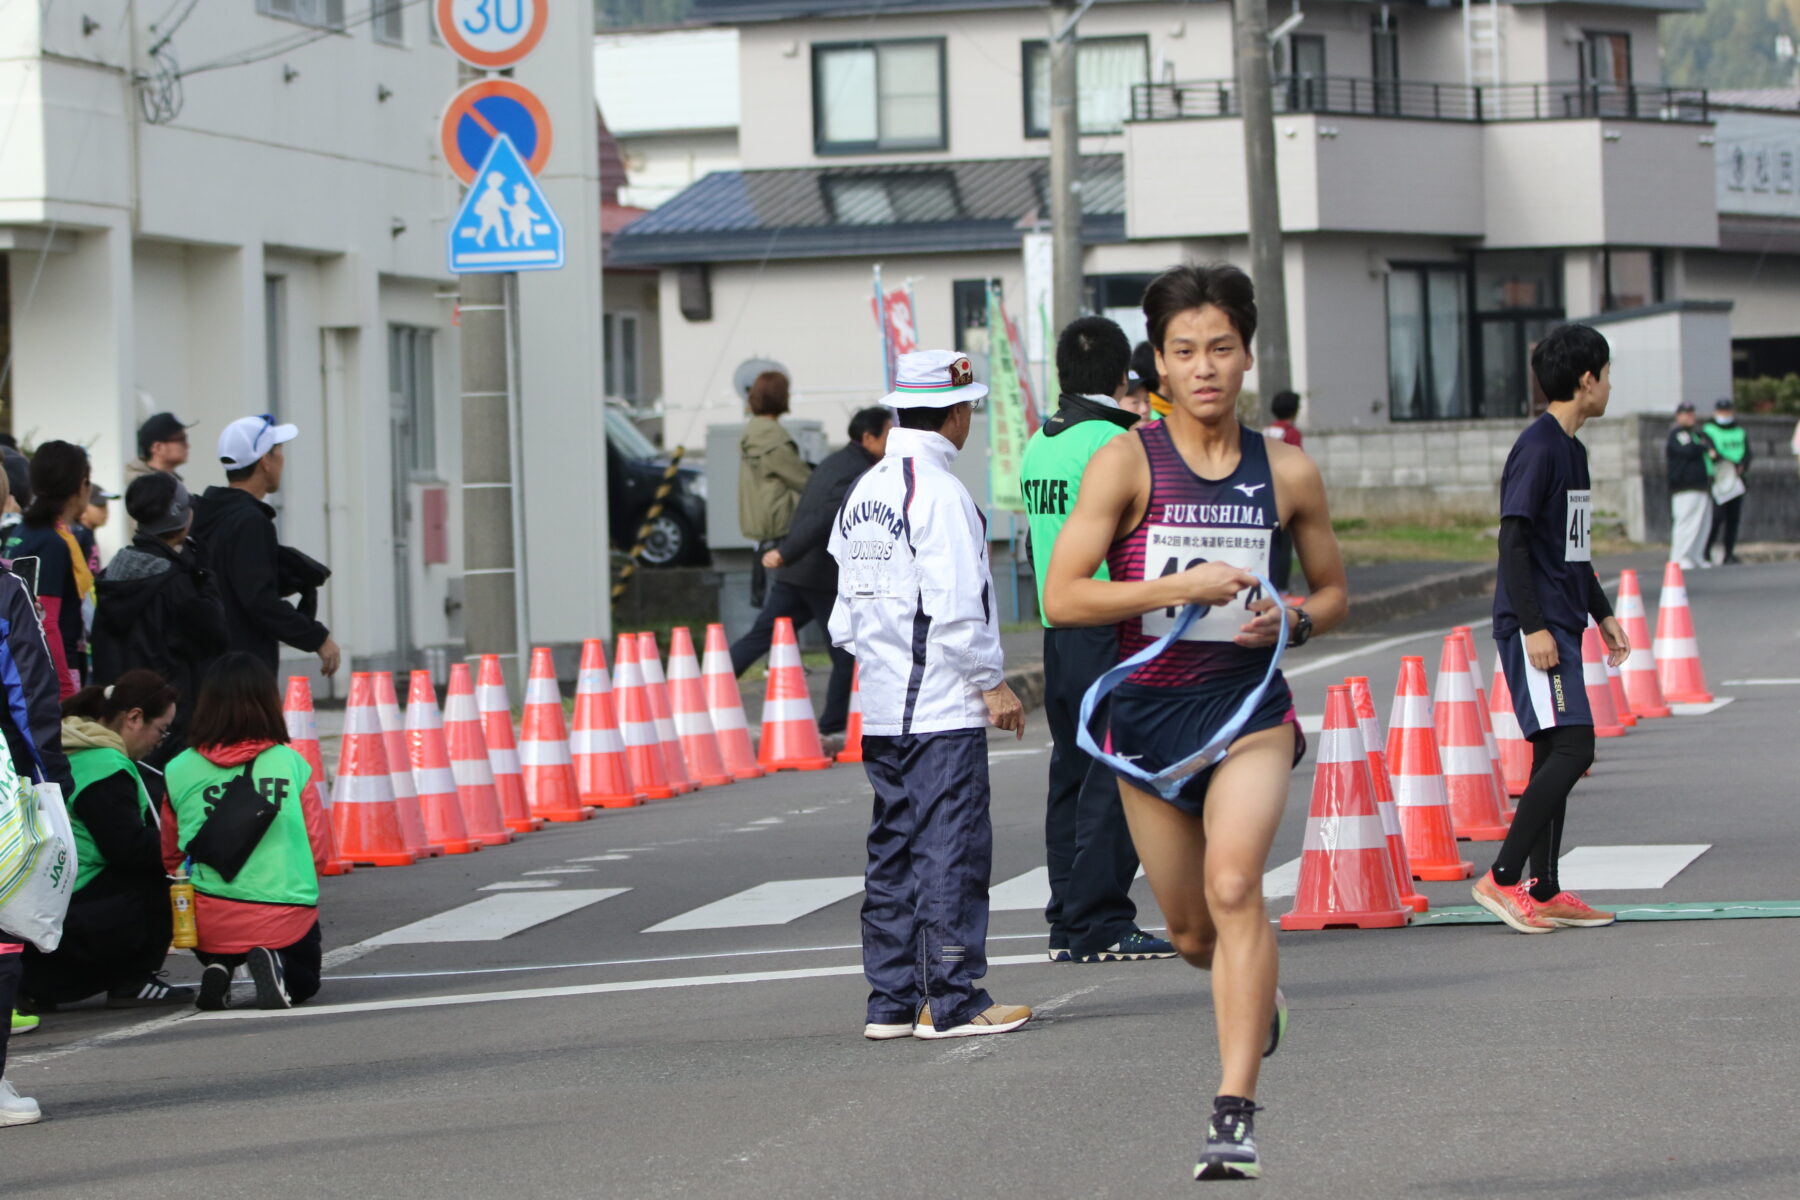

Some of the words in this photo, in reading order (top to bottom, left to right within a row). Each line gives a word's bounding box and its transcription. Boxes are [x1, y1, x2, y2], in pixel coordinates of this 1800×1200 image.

[463, 0, 523, 34] 30
[1023, 479, 1068, 515] STAFF
[1161, 504, 1264, 526] FUKUSHIMA
